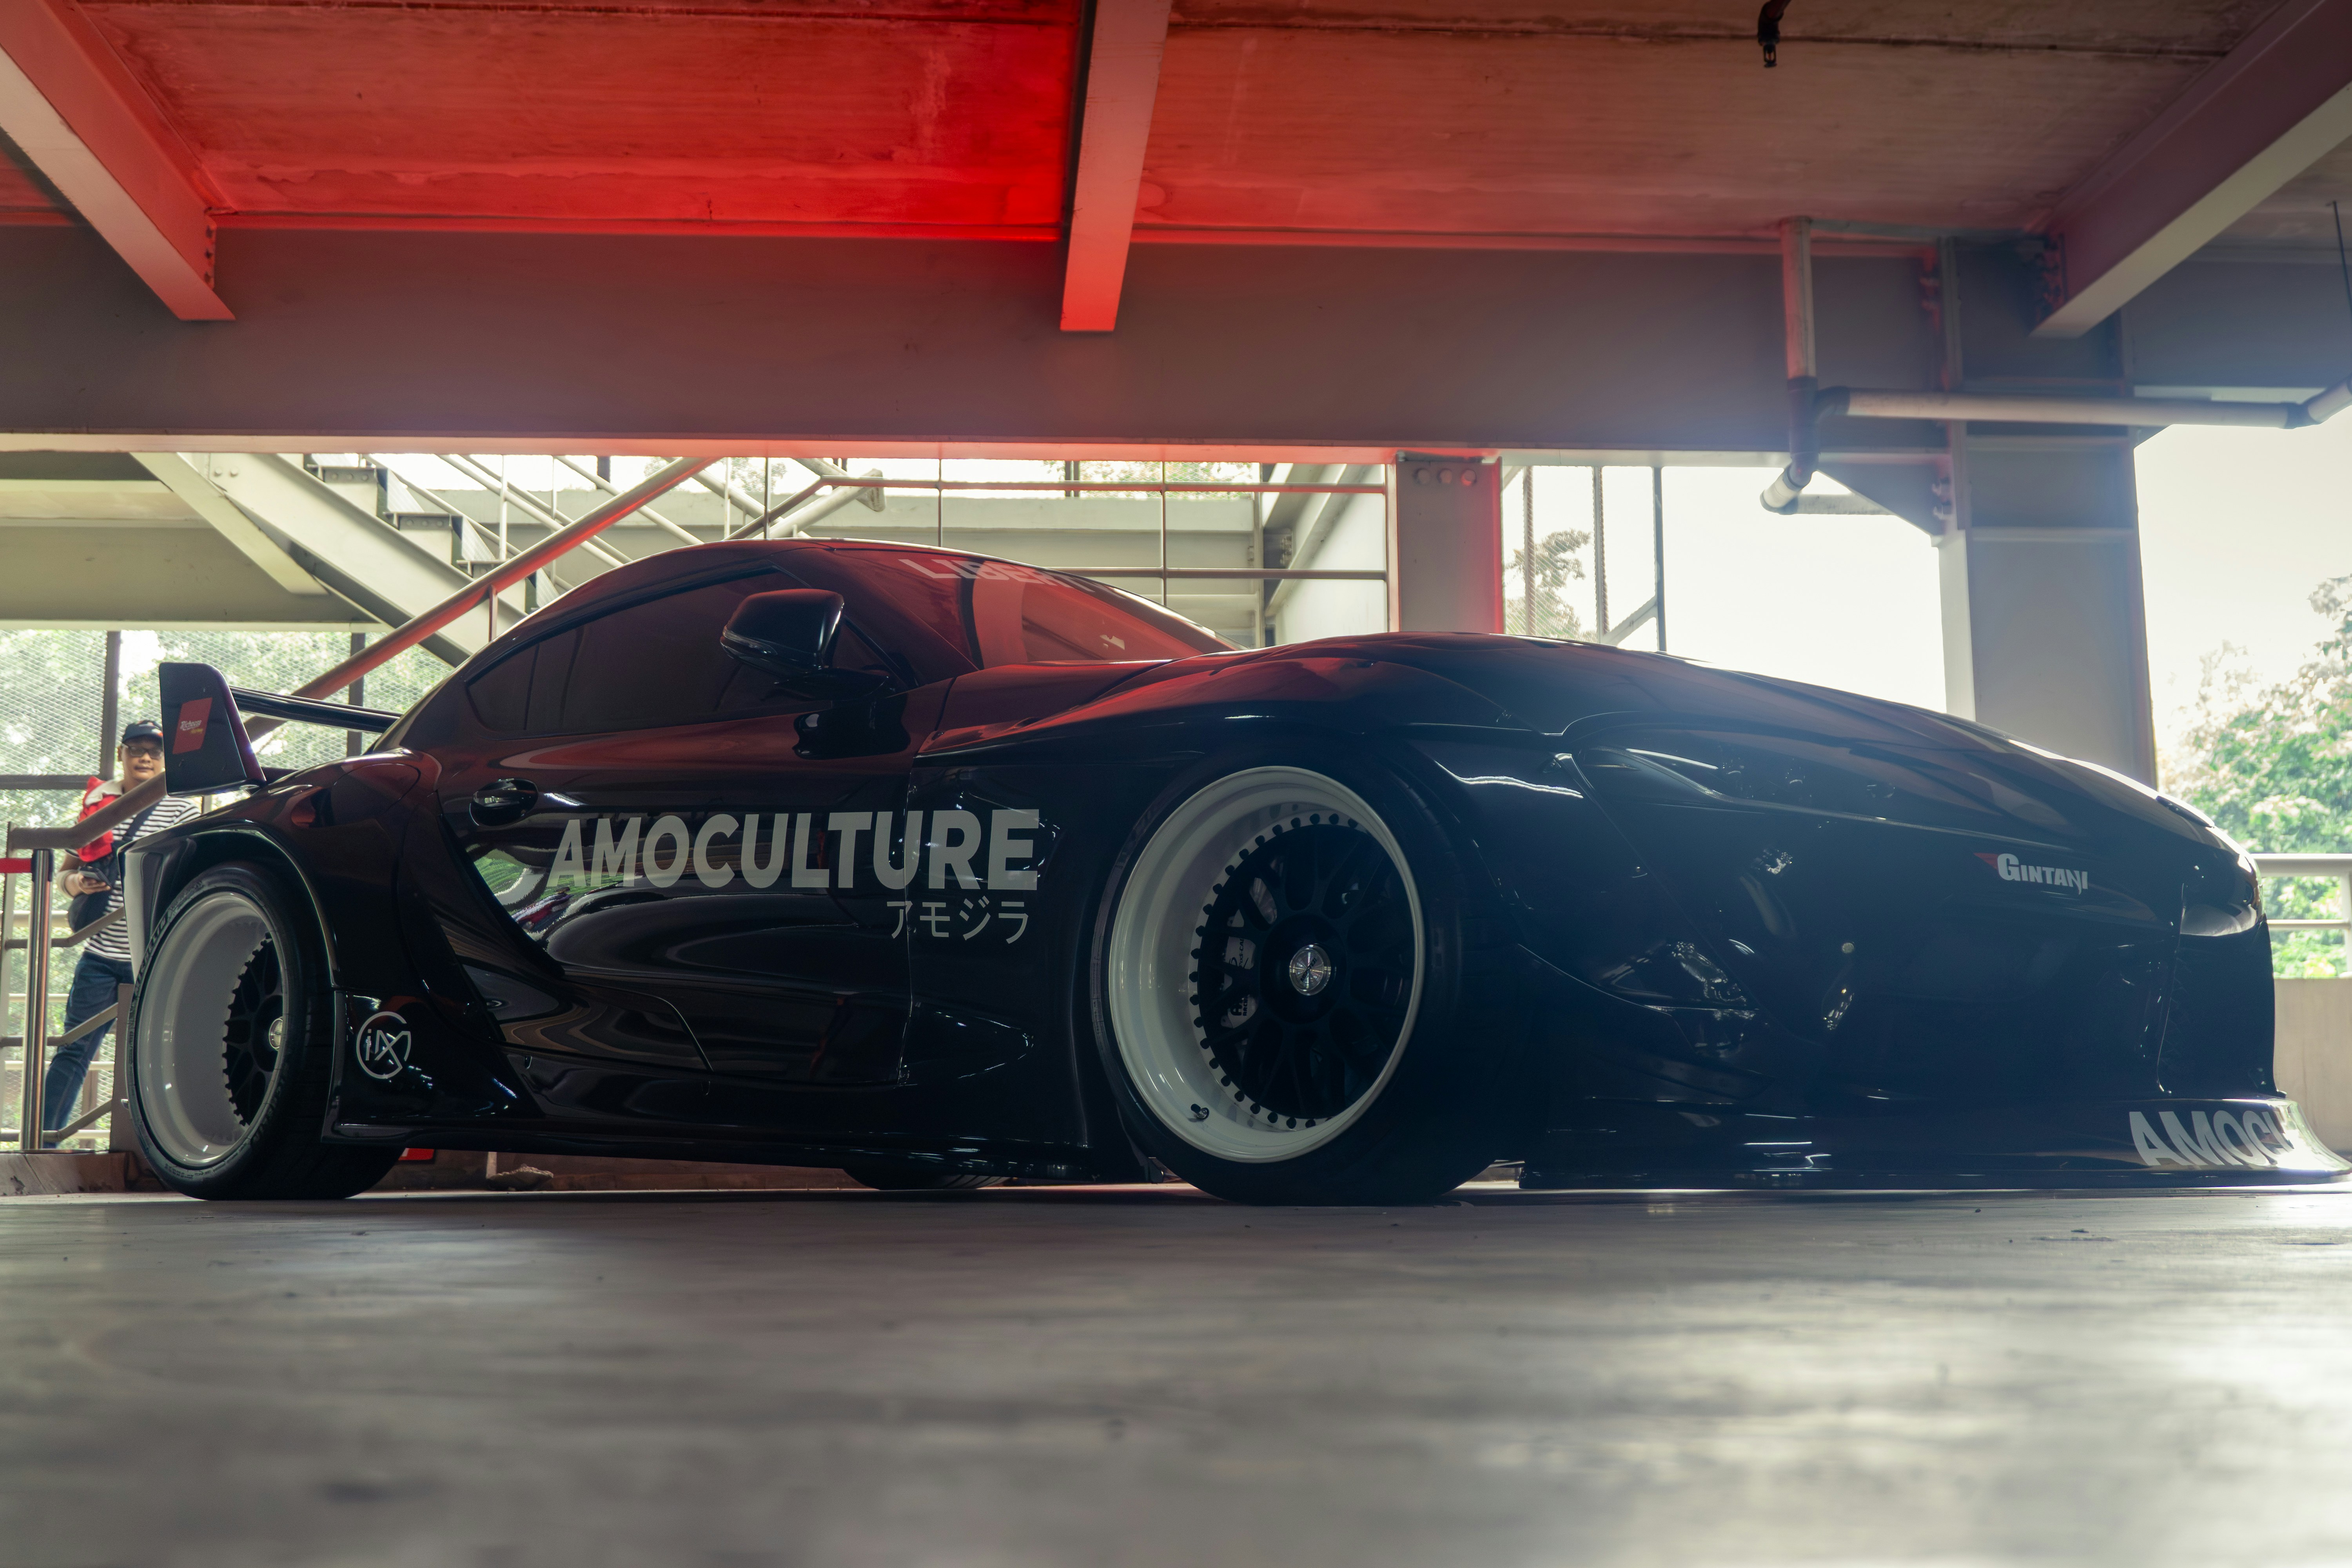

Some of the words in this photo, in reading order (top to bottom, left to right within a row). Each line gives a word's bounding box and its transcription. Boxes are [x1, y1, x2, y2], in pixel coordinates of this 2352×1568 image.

[546, 808, 1040, 890] AMOCULTURE
[886, 895, 1031, 944] アモジラ
